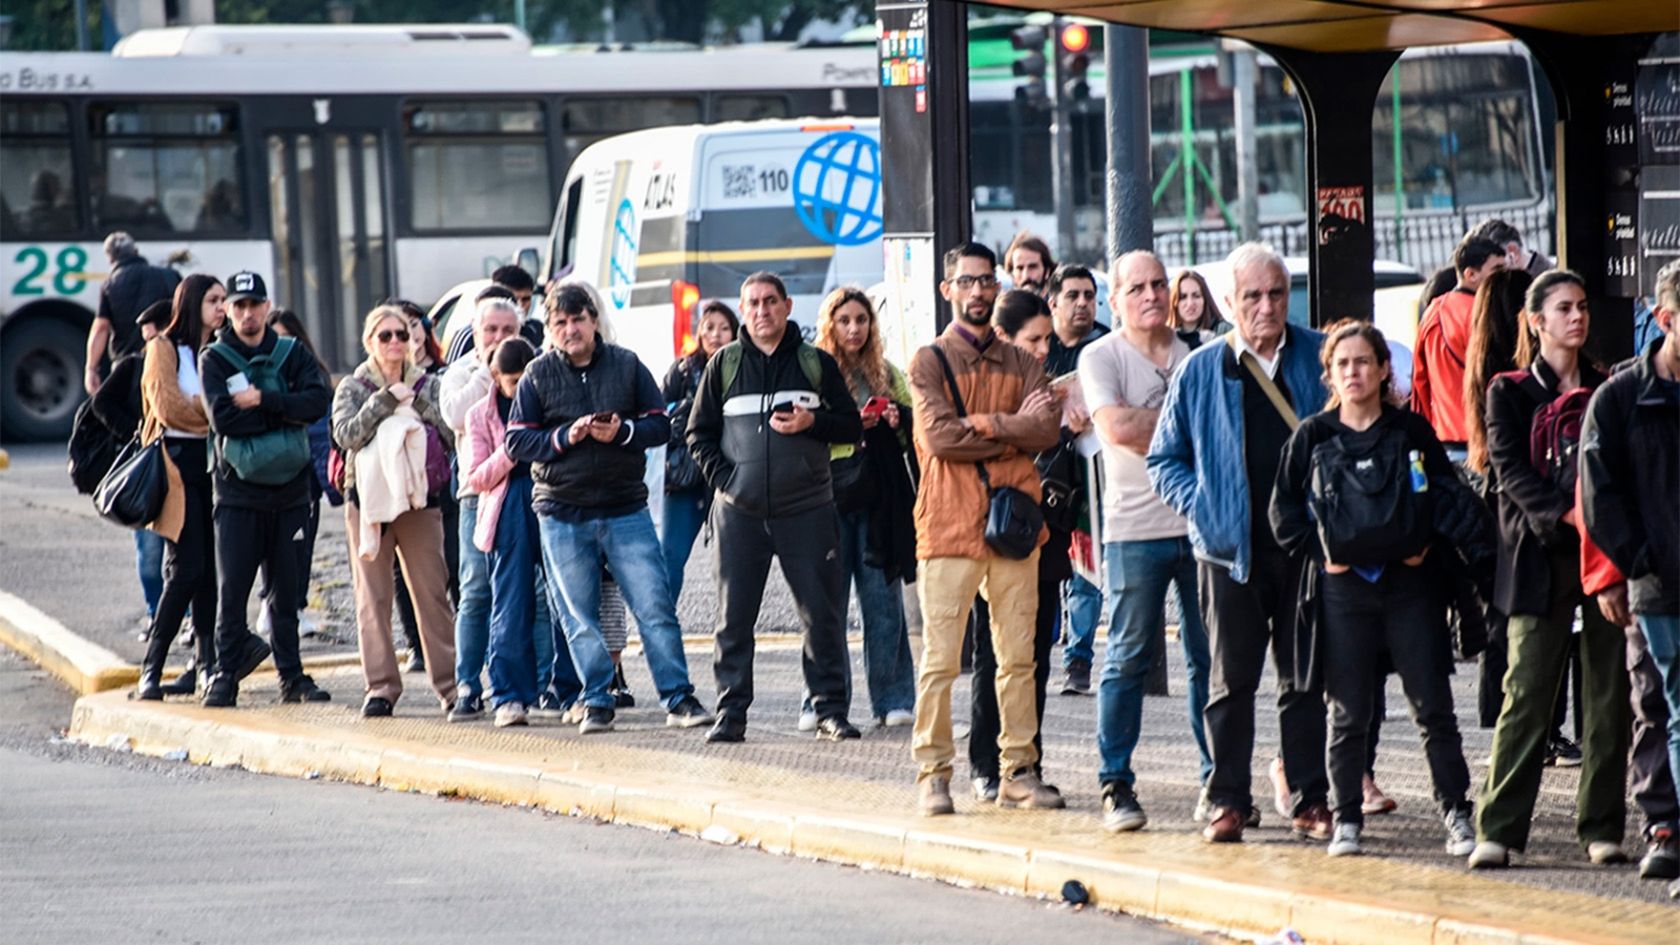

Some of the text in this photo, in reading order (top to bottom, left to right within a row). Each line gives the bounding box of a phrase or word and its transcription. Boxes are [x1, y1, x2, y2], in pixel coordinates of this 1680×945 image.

[643, 172, 677, 211] ATLAS
[758, 168, 790, 193] 110
[11, 244, 88, 296] 28
